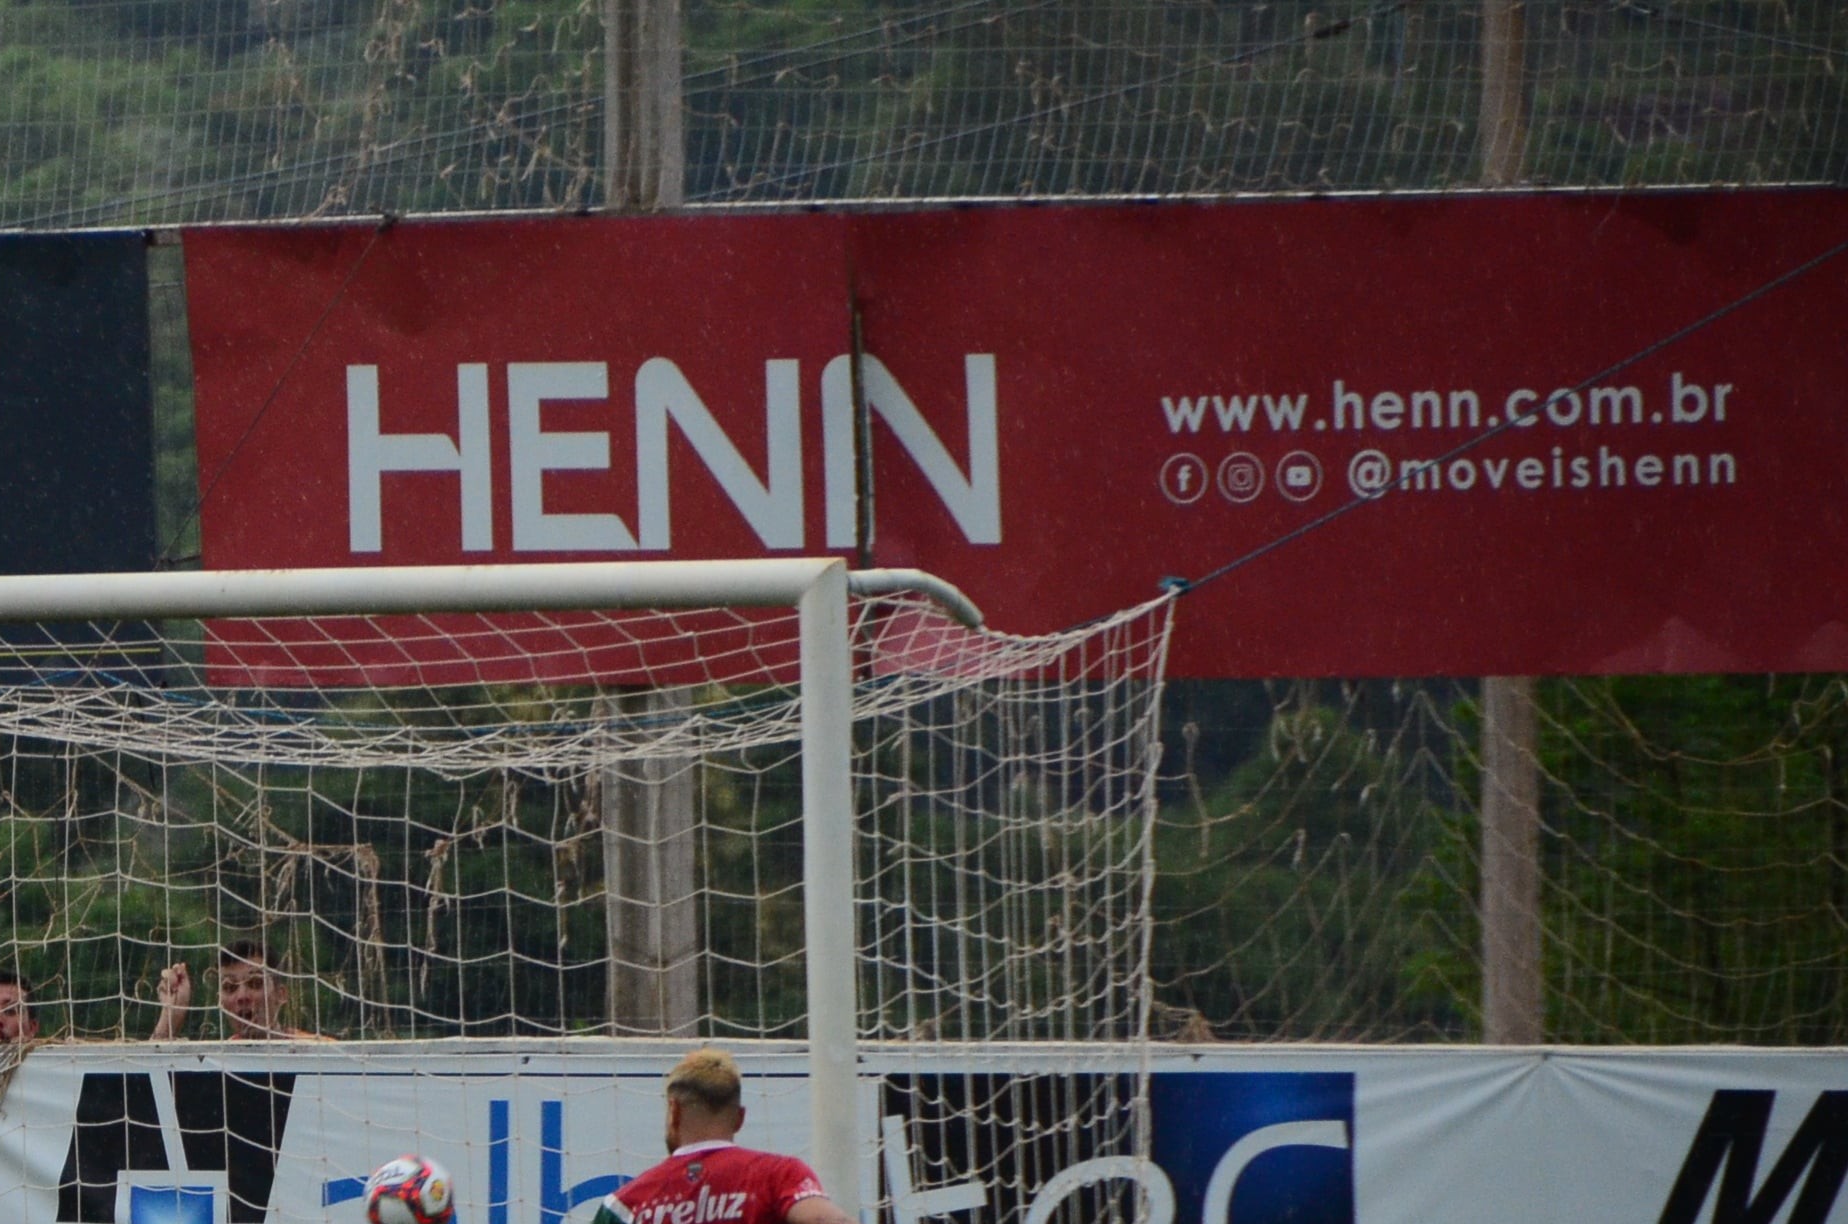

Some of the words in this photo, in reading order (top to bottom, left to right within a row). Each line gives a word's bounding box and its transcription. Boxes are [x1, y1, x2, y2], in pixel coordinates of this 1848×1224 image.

[1161, 372, 1734, 433] www.henn.com.br
[347, 353, 1002, 552] HENN
[1347, 447, 1737, 500] @moveishenn
